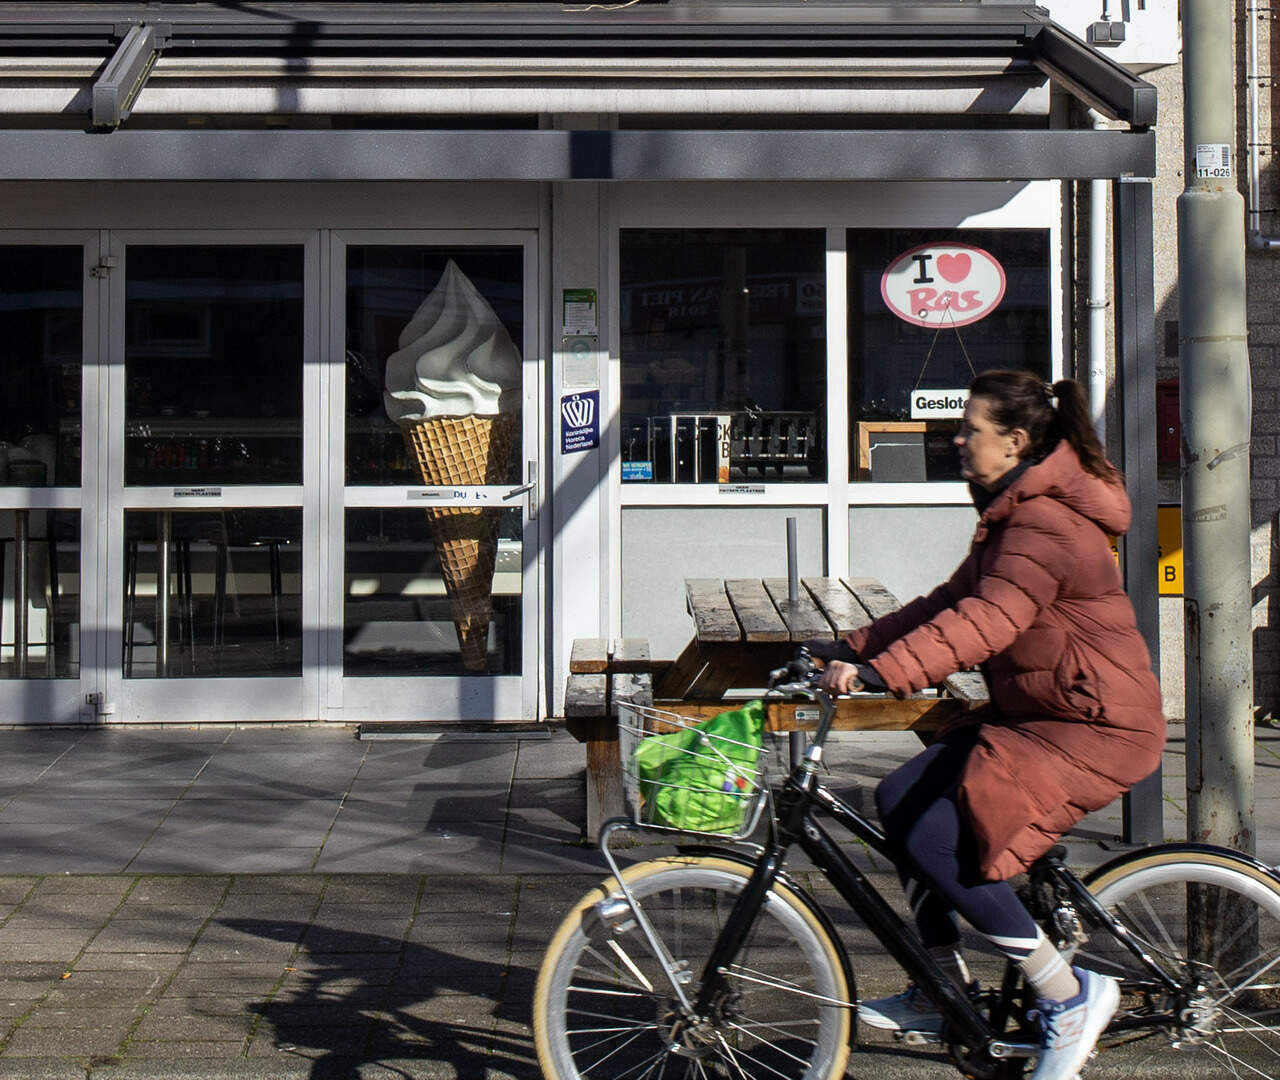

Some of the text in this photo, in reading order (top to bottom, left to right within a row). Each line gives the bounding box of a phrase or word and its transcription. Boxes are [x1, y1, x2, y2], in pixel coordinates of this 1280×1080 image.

[912, 254, 934, 284] I
[906, 287, 983, 316] Ras
[916, 397, 970, 410] Geslot
[566, 440, 593, 450] Nederland
[1164, 565, 1177, 582] B
